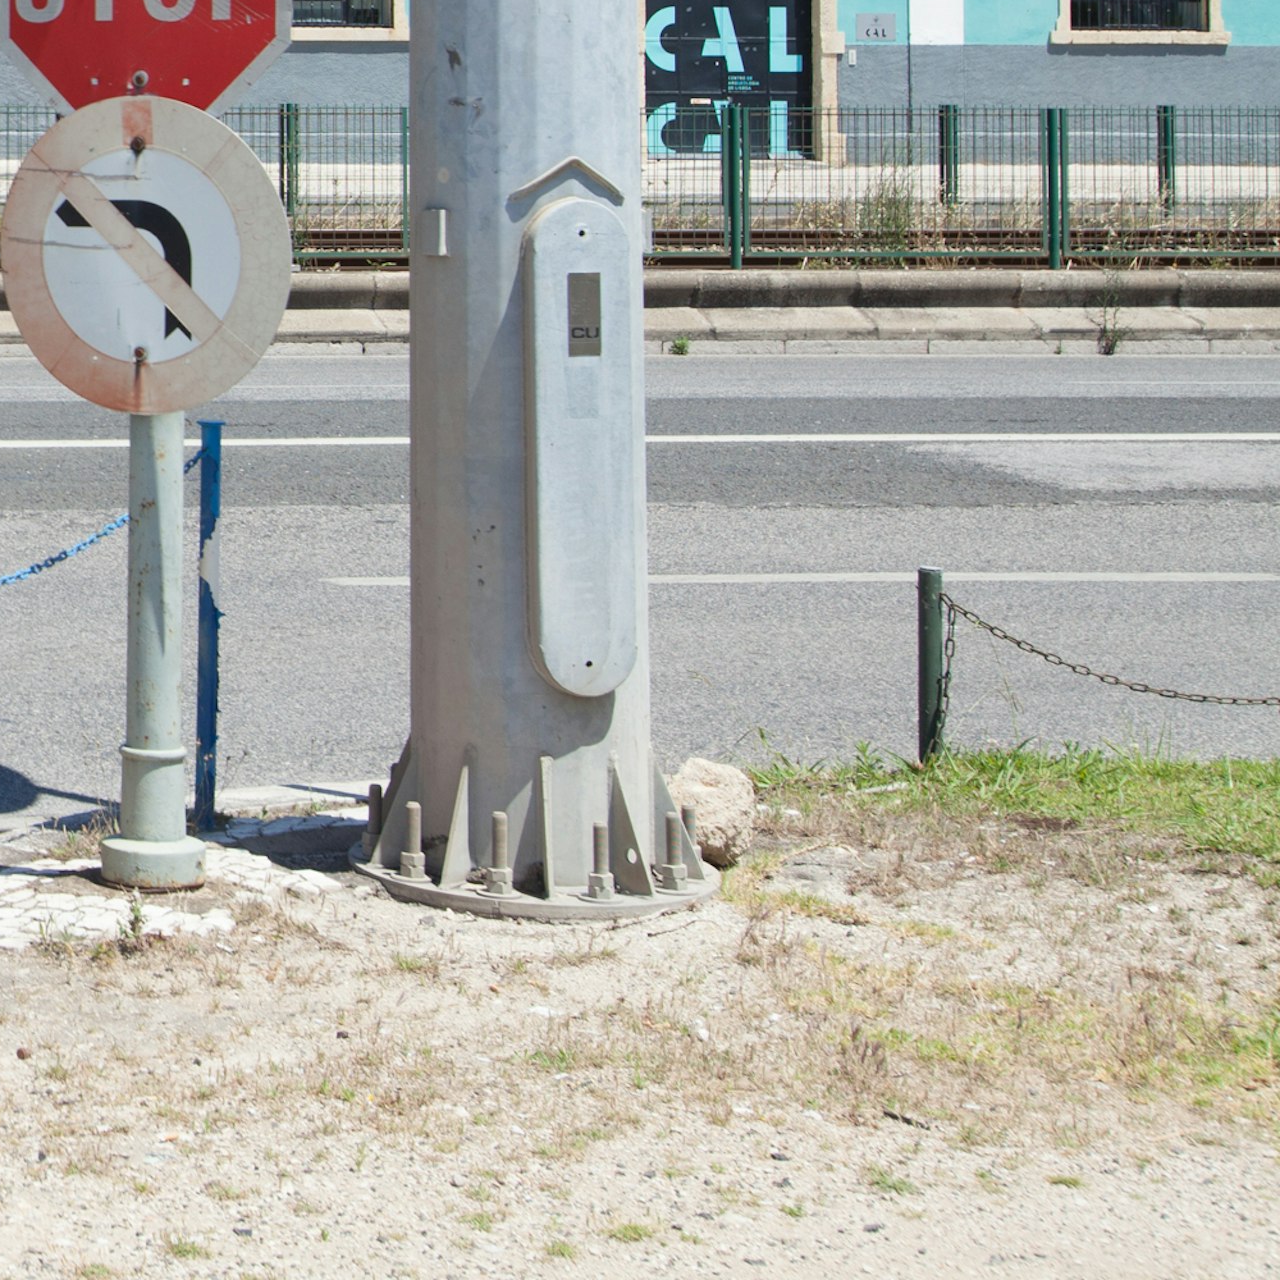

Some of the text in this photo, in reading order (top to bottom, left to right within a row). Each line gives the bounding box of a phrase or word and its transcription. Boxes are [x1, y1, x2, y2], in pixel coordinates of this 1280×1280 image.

[645, 6, 803, 72] CAL
[865, 28, 887, 38] CAL
[571, 327, 599, 339] CU
